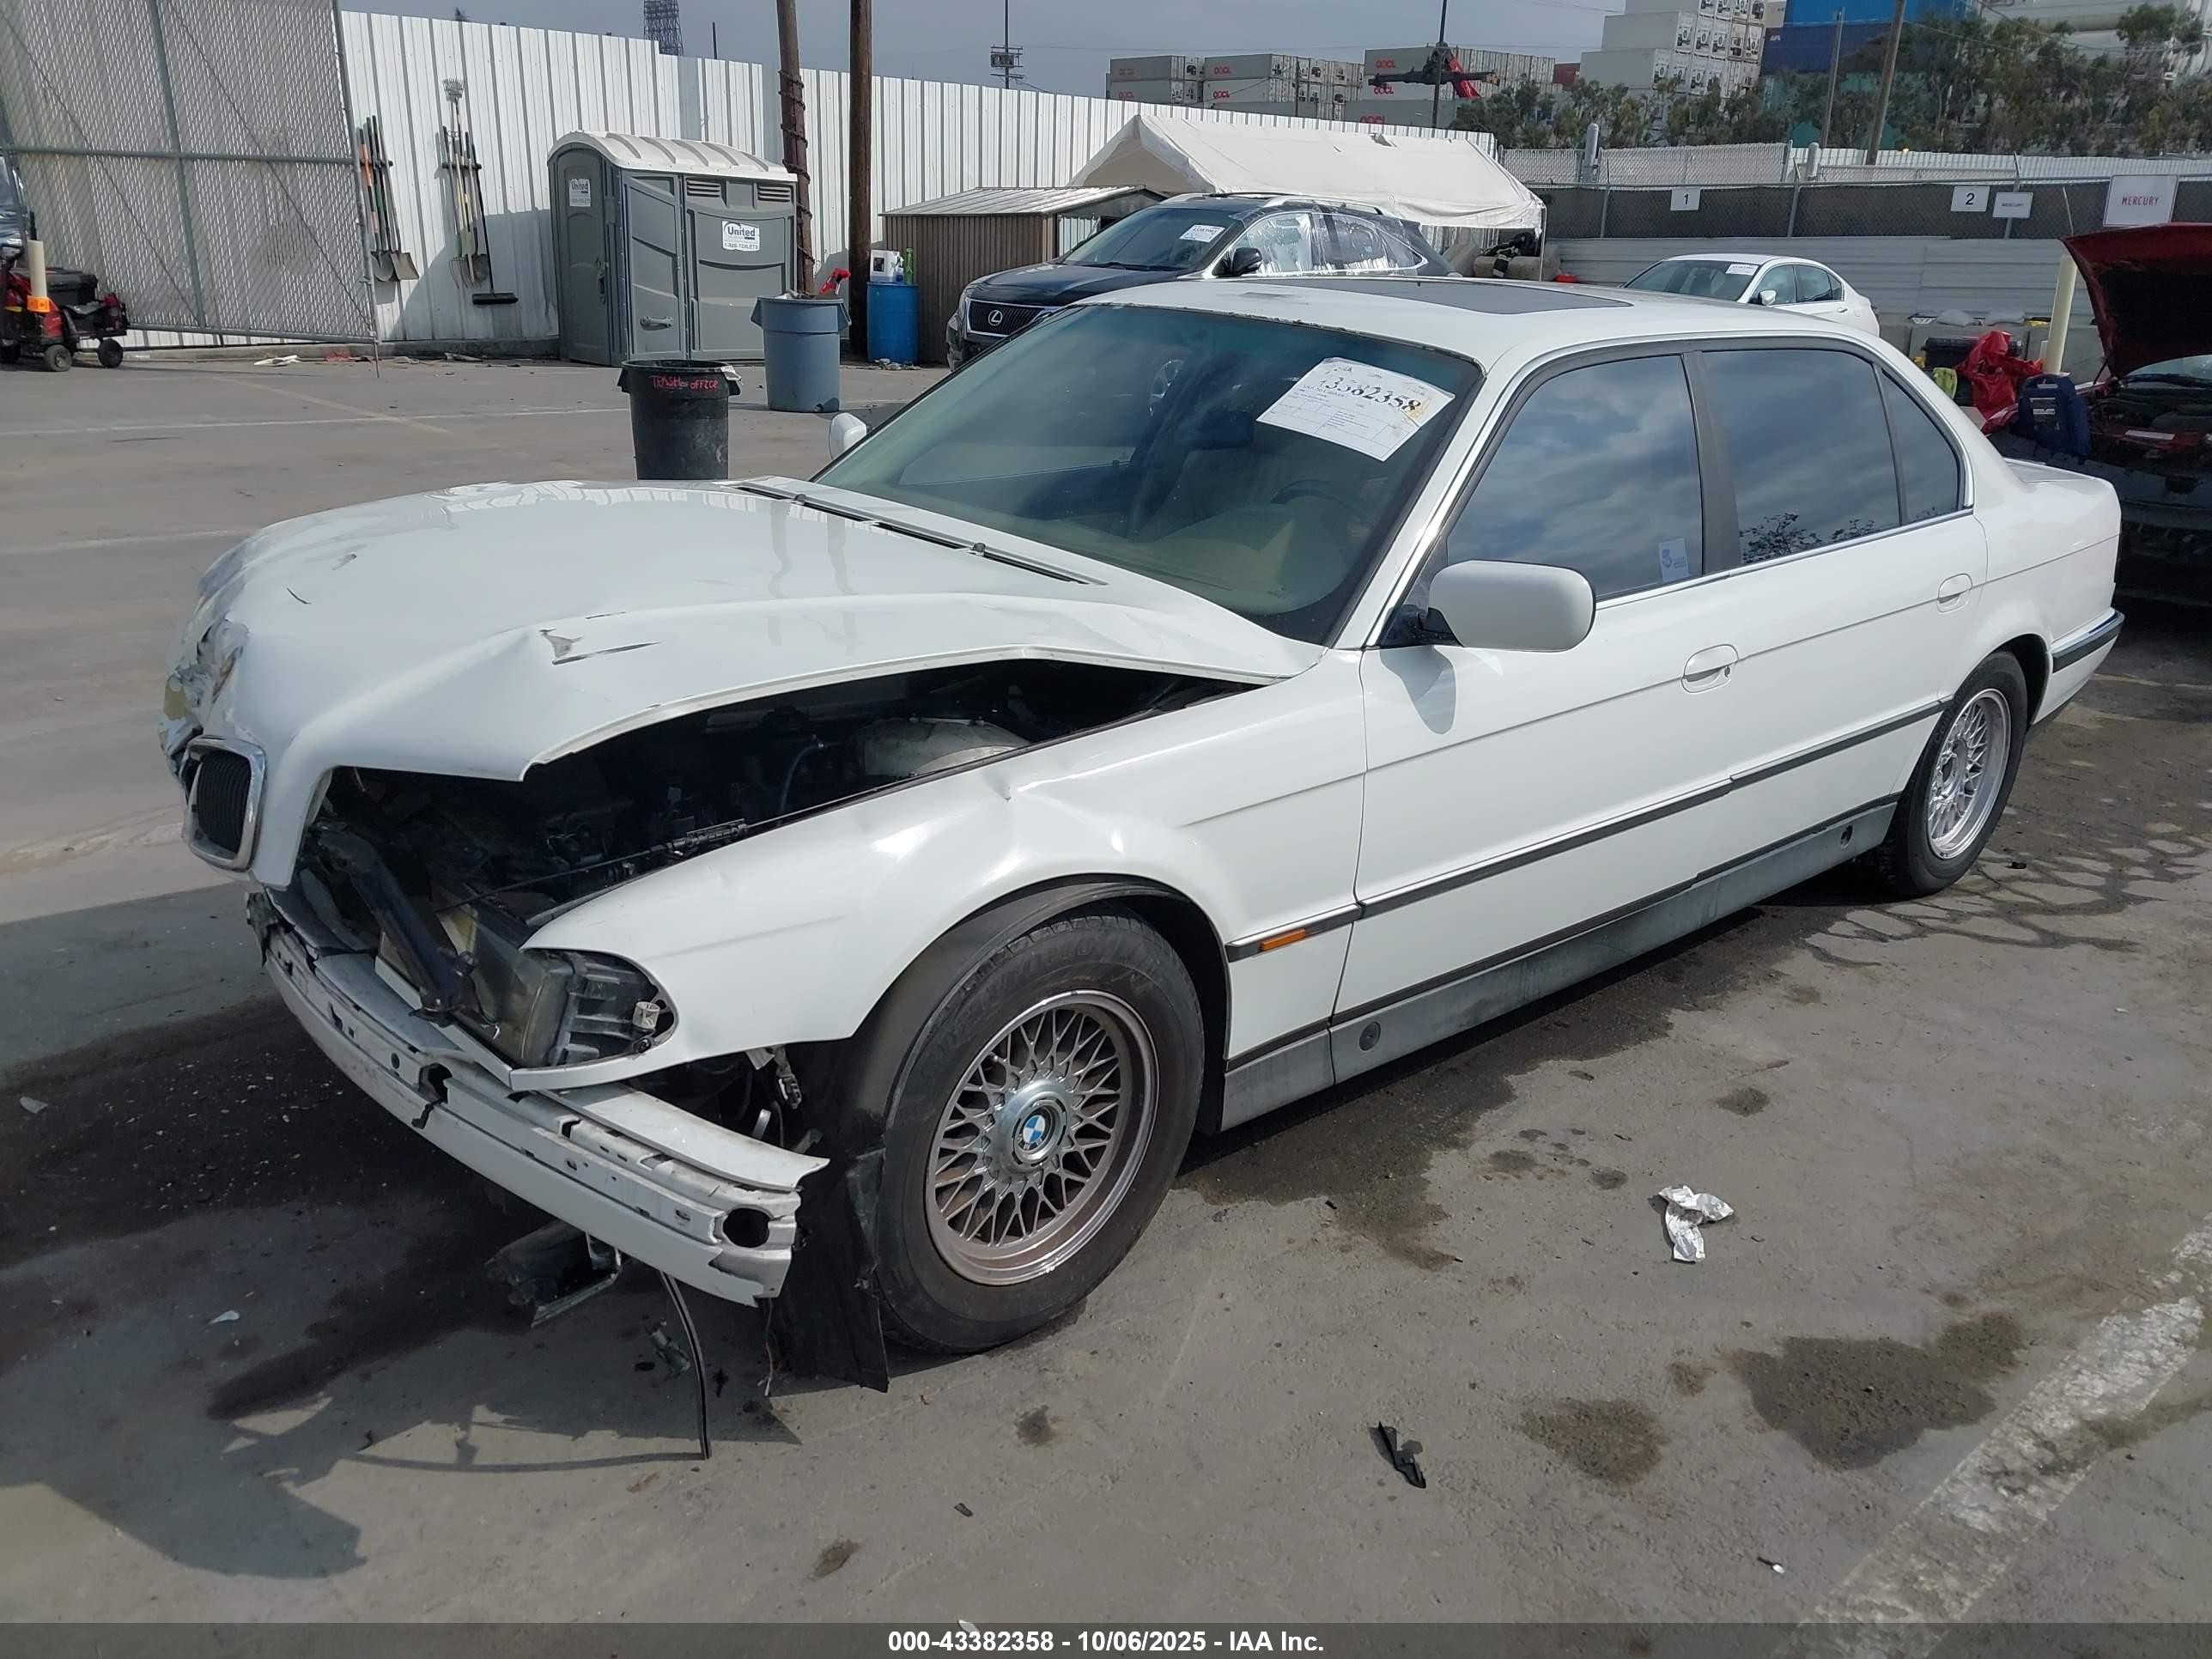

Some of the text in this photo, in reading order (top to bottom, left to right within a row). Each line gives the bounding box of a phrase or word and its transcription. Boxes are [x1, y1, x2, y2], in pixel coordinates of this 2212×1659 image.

[1683, 193, 1689, 205] 1
[1965, 192, 1975, 206] 2
[2122, 195, 2160, 206] MERCURY
[727, 226, 756, 237] United
